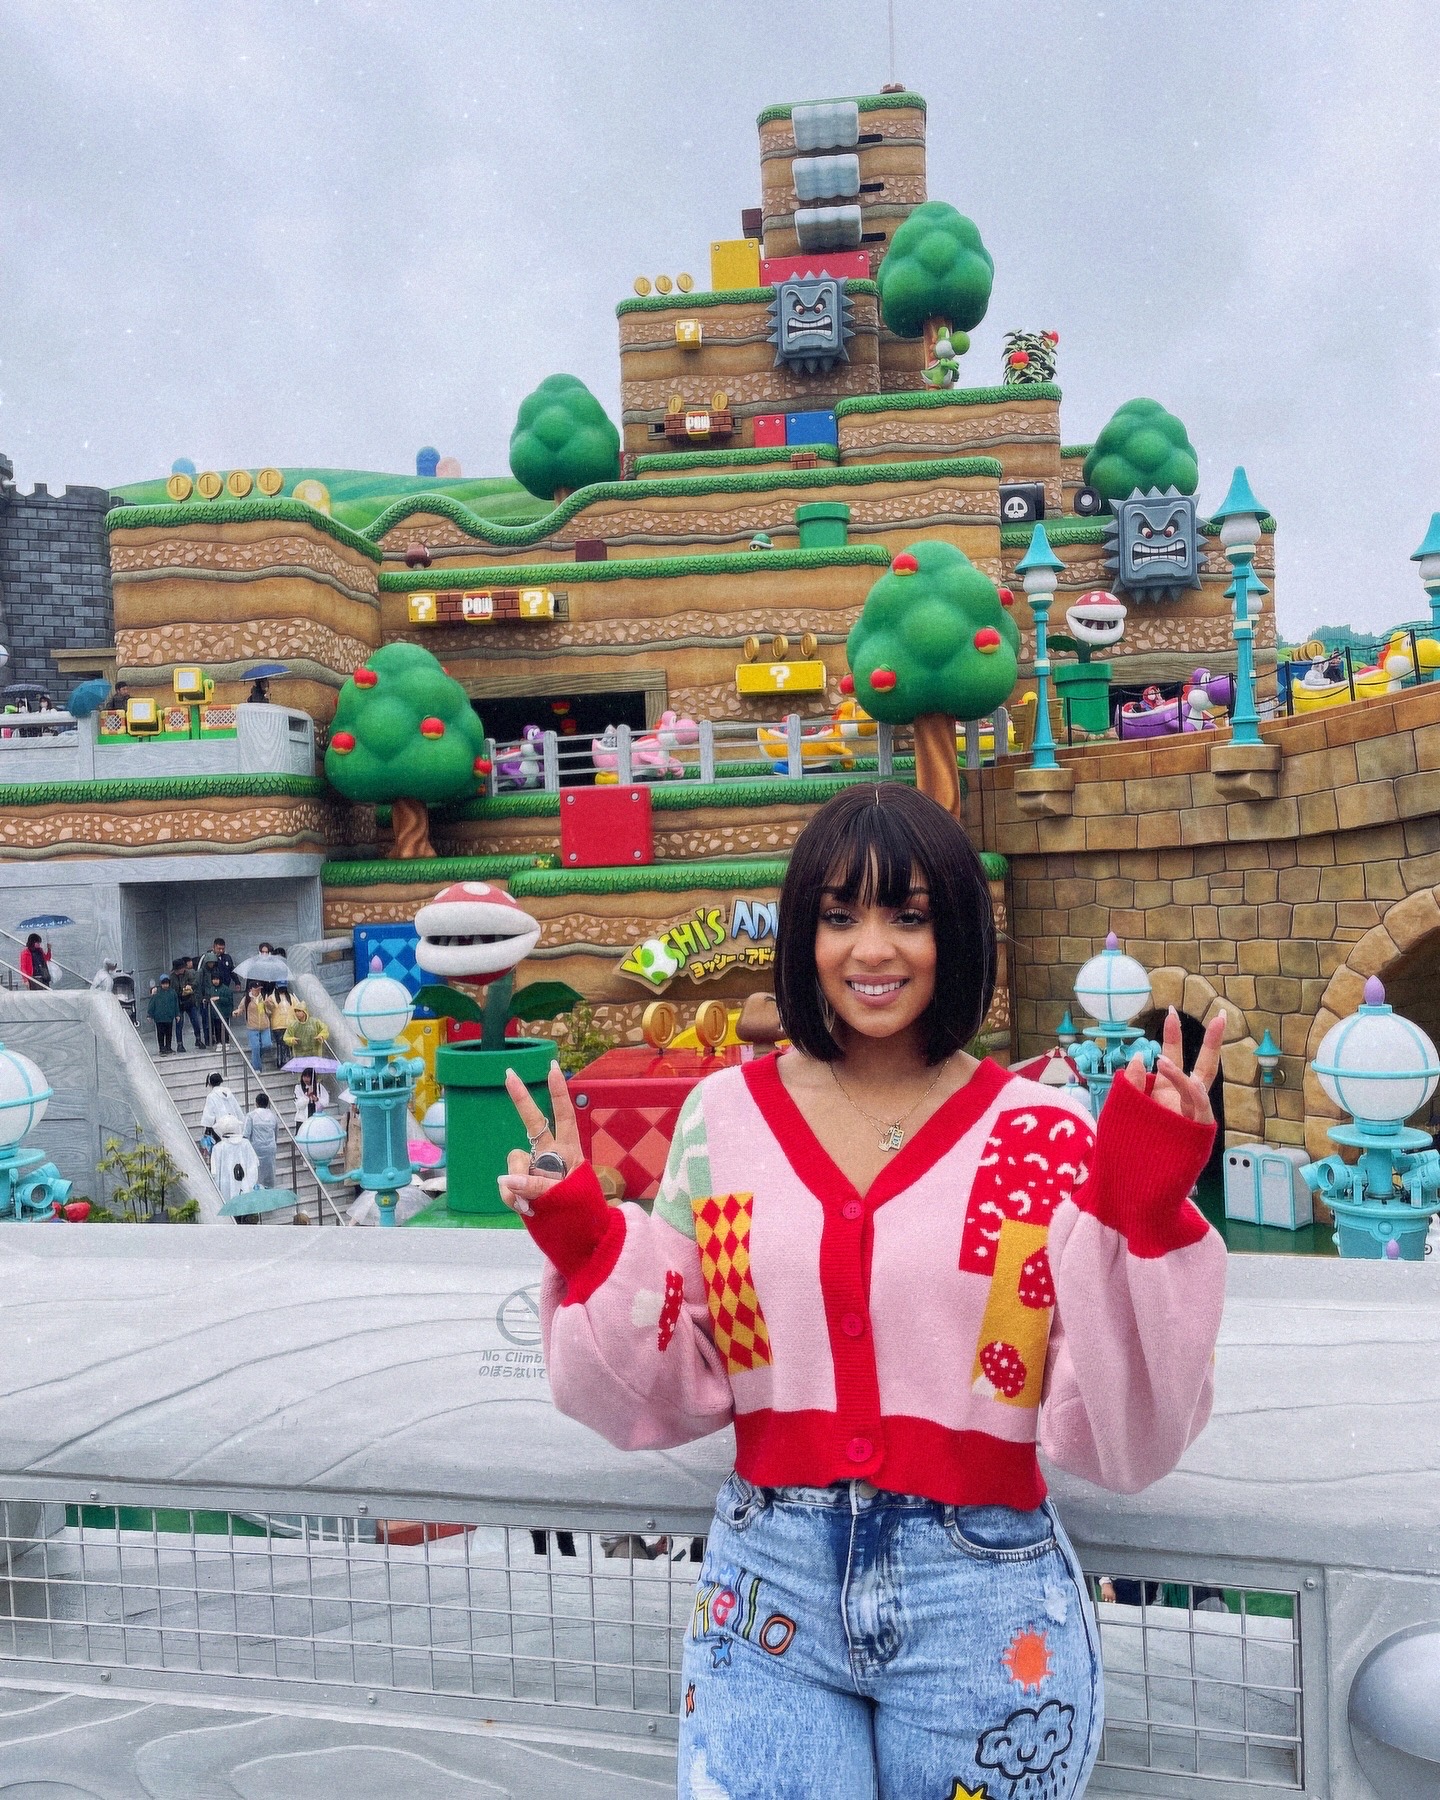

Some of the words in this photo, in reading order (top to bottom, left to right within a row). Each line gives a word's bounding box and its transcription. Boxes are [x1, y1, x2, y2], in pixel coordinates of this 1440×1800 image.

[462, 597, 493, 614] POW
[621, 908, 726, 986] YOSHI'S
[481, 1350, 500, 1362] No
[505, 1351, 545, 1364] Climb
